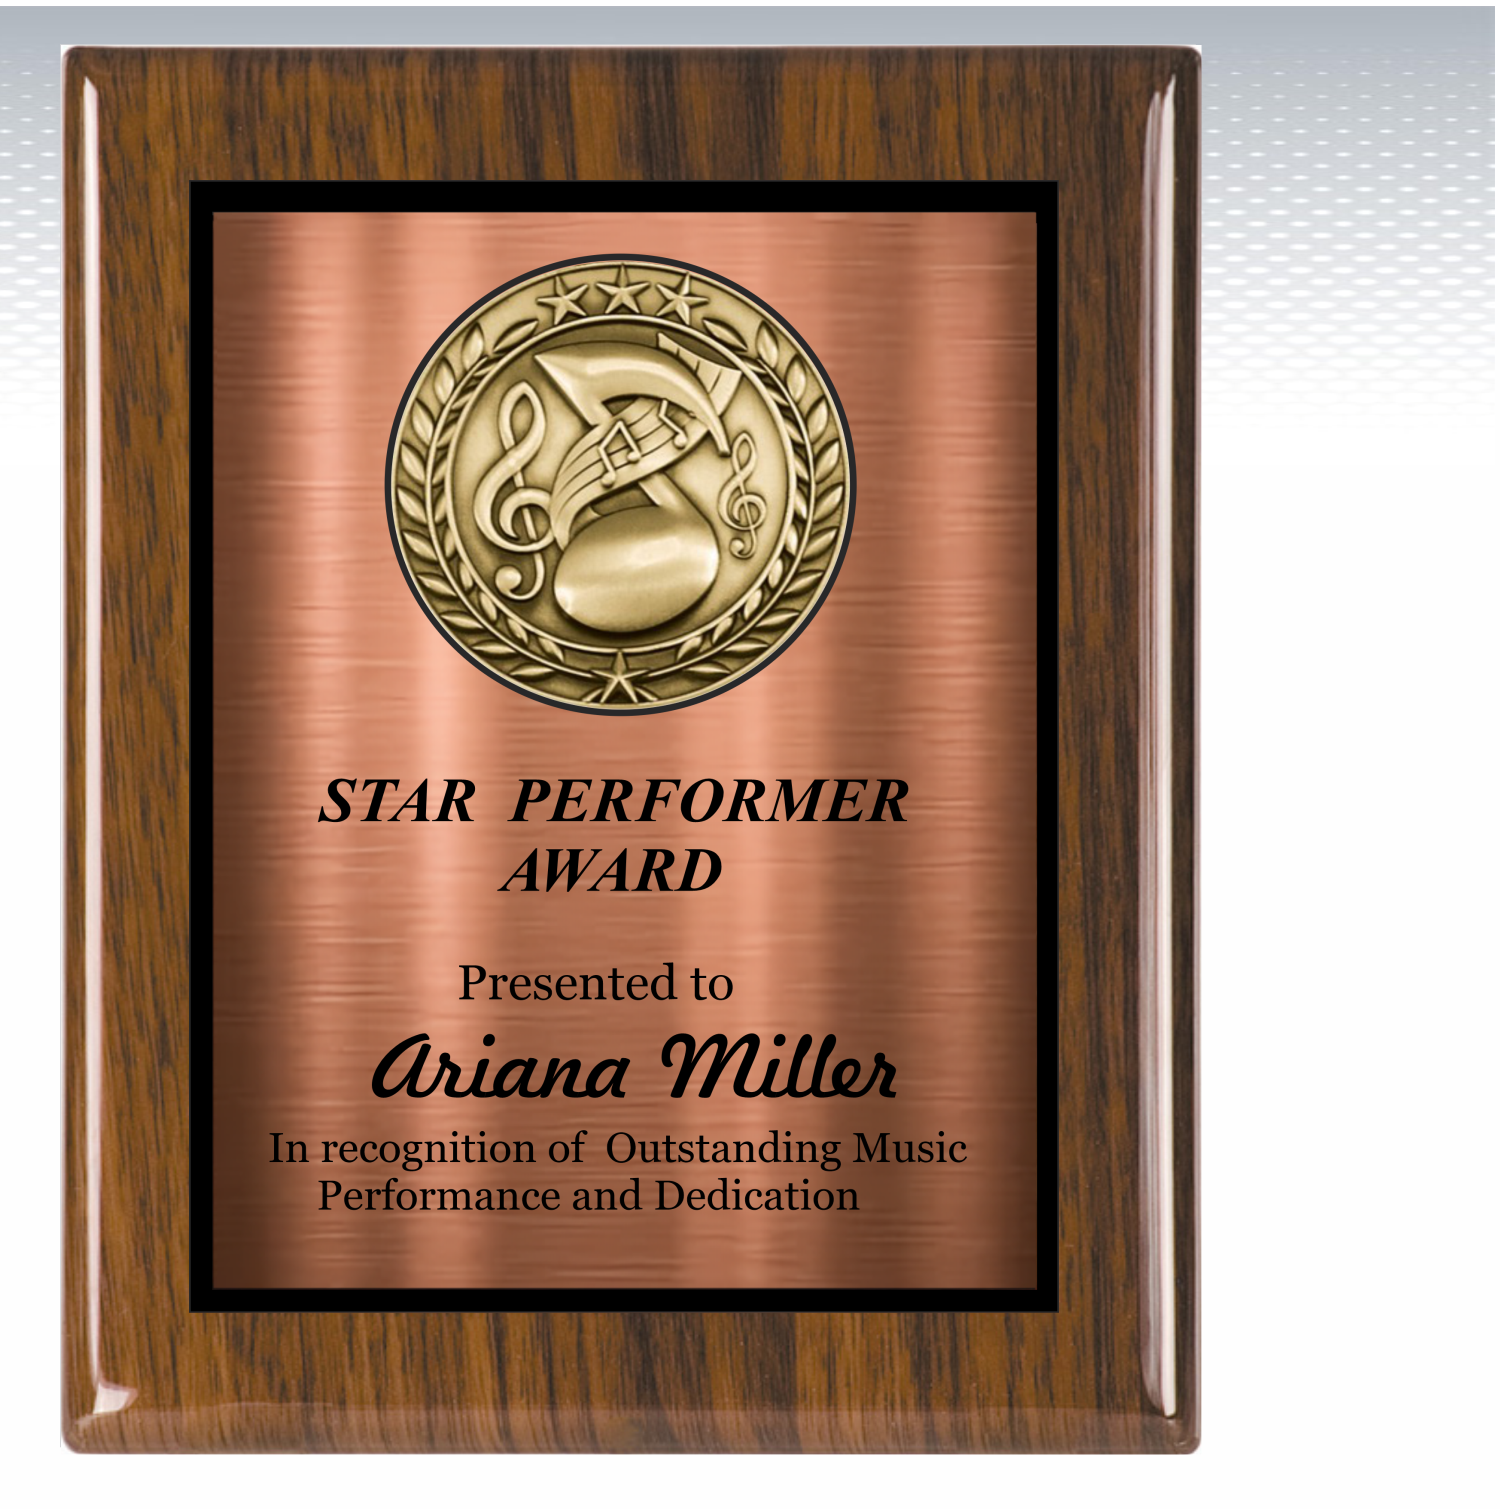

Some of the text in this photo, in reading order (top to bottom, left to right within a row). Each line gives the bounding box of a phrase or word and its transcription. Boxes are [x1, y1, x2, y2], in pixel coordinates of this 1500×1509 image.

[317, 778, 909, 823] STAR PERFORMER
[497, 847, 722, 893] AWARD
[458, 962, 733, 1001] Presented to
[371, 1033, 897, 1099] Ariana Miller
[268, 1129, 968, 1172] In recognition of Outstanding Music
[318, 1177, 860, 1211] Performance and Dedication
